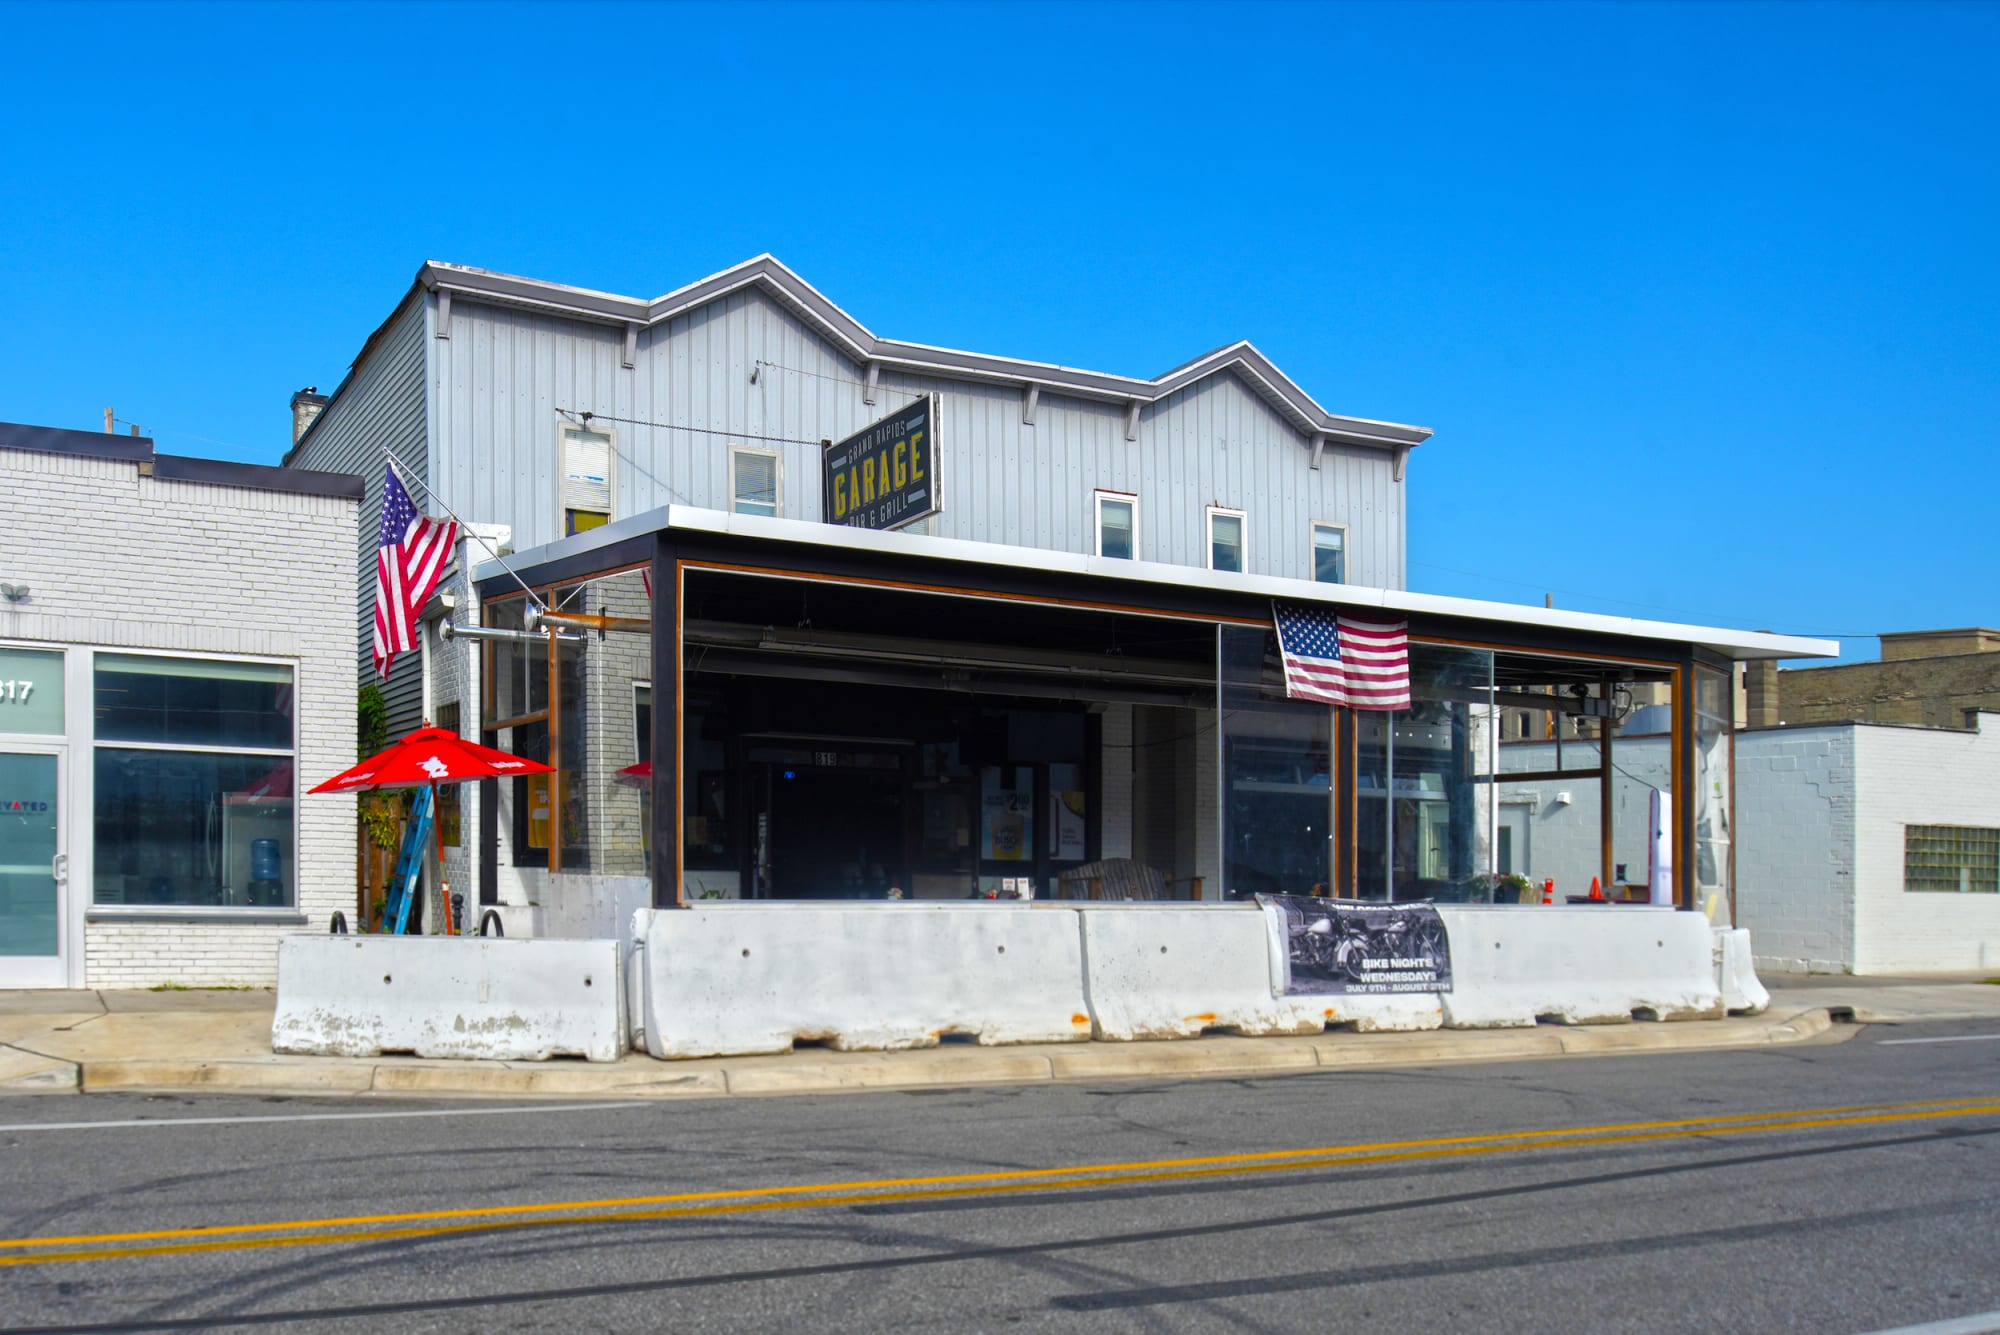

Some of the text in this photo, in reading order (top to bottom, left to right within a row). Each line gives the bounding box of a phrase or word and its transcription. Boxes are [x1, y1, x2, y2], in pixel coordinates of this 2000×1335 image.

[848, 421, 905, 464] GRAND RAPIDS
[834, 431, 924, 519] GARAGE
[850, 514, 866, 528] BAR
[880, 492, 908, 522] GRILL
[0, 800, 48, 812] VATED
[1363, 957, 1433, 969] BIKE NIGHTS
[1360, 972, 1437, 983] WEDNESDAYS
[1346, 984, 1367, 993] JULY
[1392, 983, 1427, 992] AUGUST
